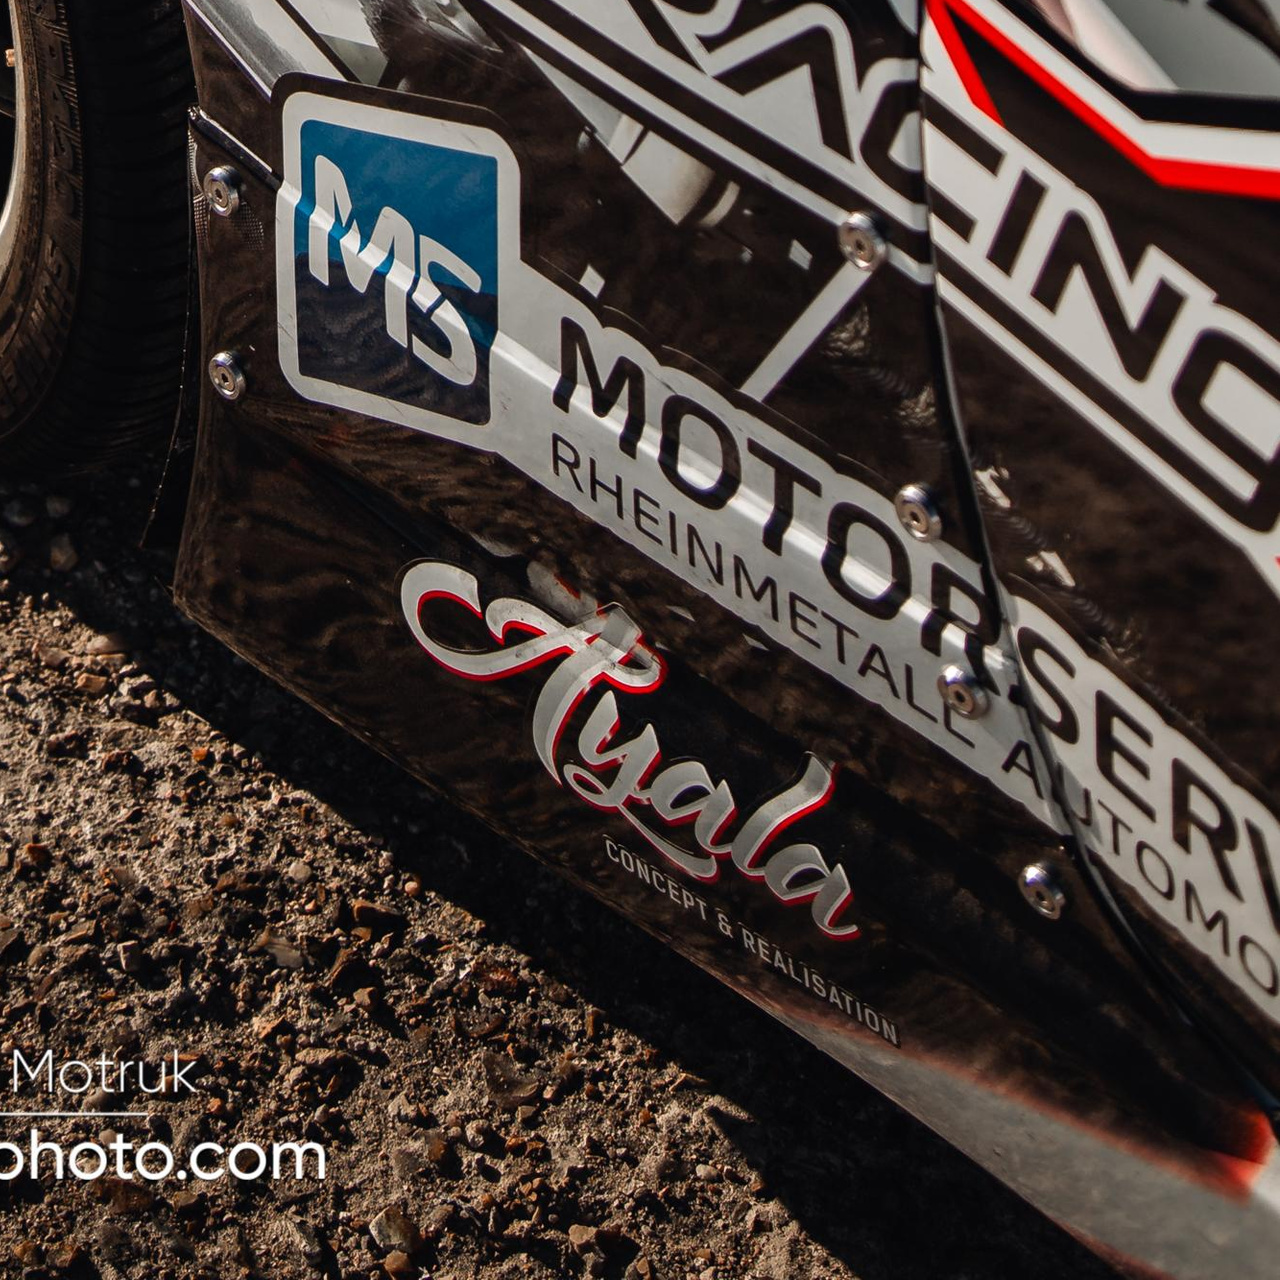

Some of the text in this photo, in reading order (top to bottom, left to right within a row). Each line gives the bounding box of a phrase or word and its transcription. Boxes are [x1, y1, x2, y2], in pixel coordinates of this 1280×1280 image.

[308, 154, 482, 386] MS
[551, 432, 976, 749] RHEINMETALL
[605, 839, 898, 1045] CONCEPT & REALISATION
